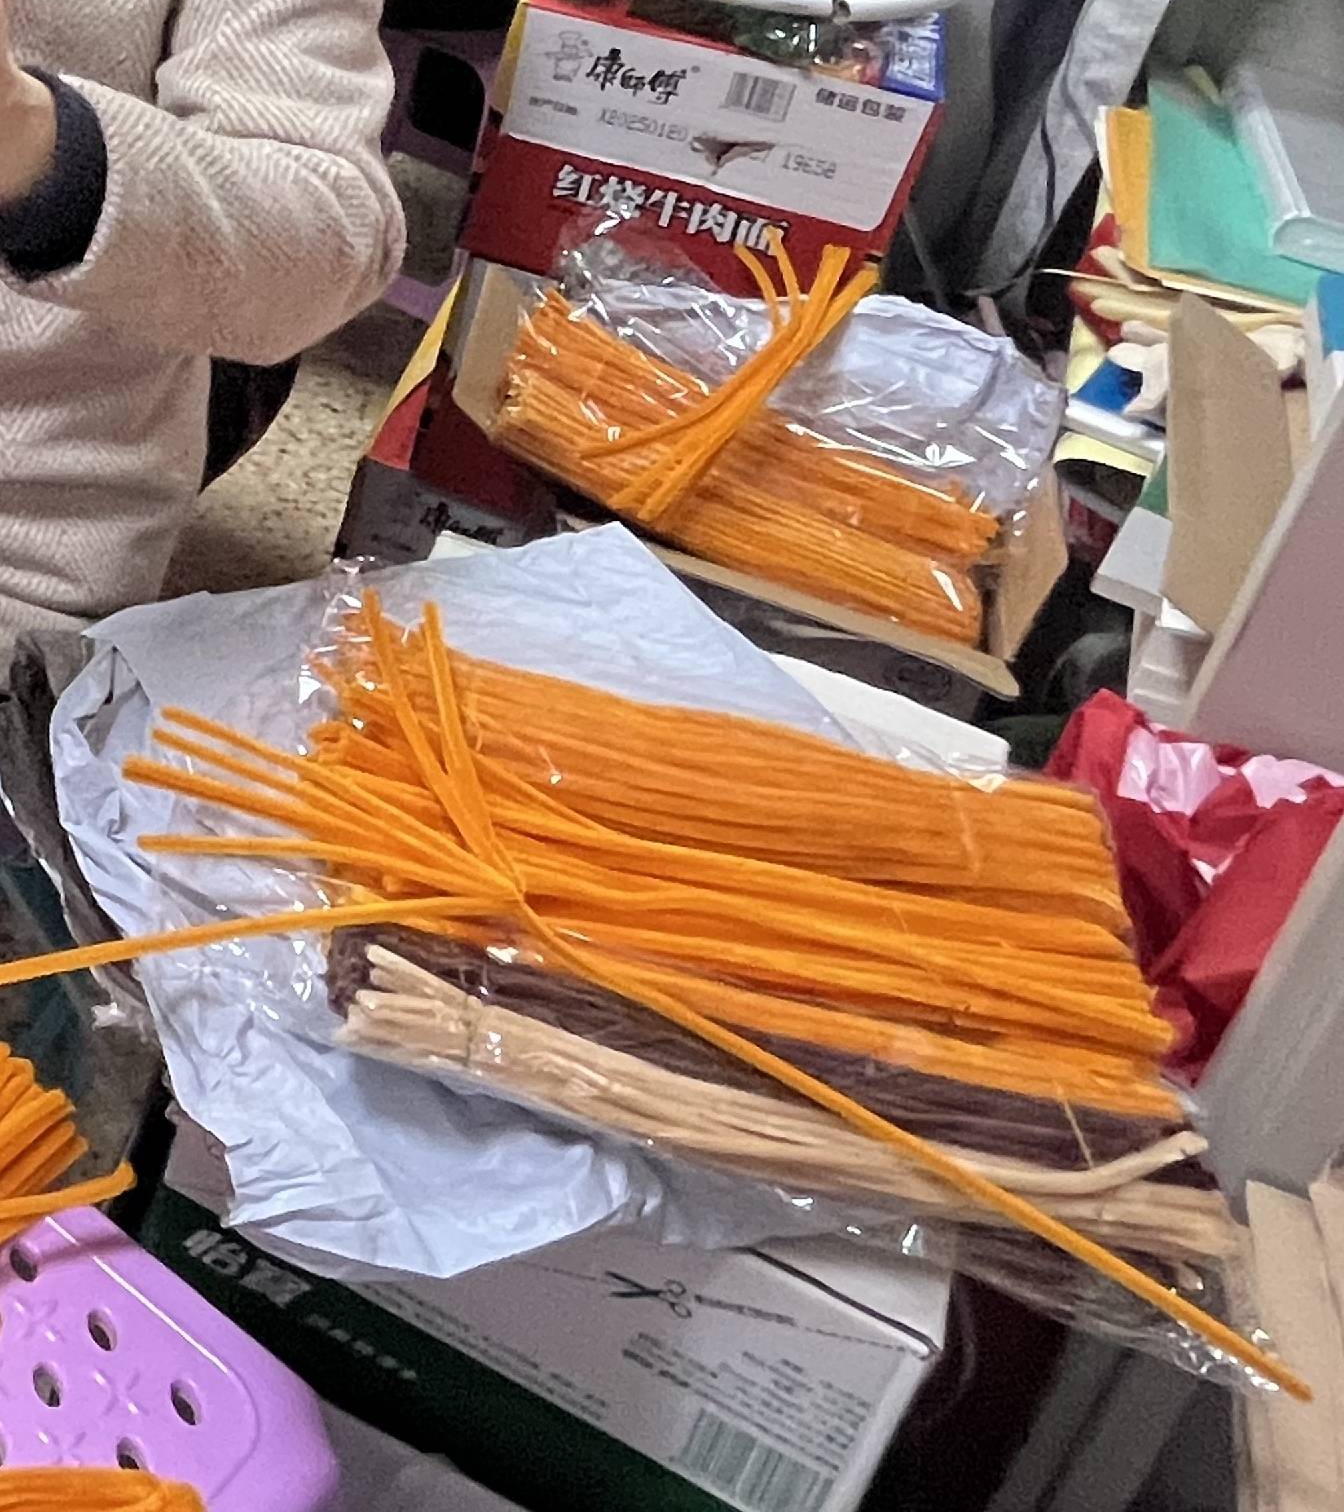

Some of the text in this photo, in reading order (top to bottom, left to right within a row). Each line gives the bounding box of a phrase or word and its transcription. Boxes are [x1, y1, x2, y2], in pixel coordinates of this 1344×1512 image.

[552, 164, 790, 256] 红烧牛肉面
